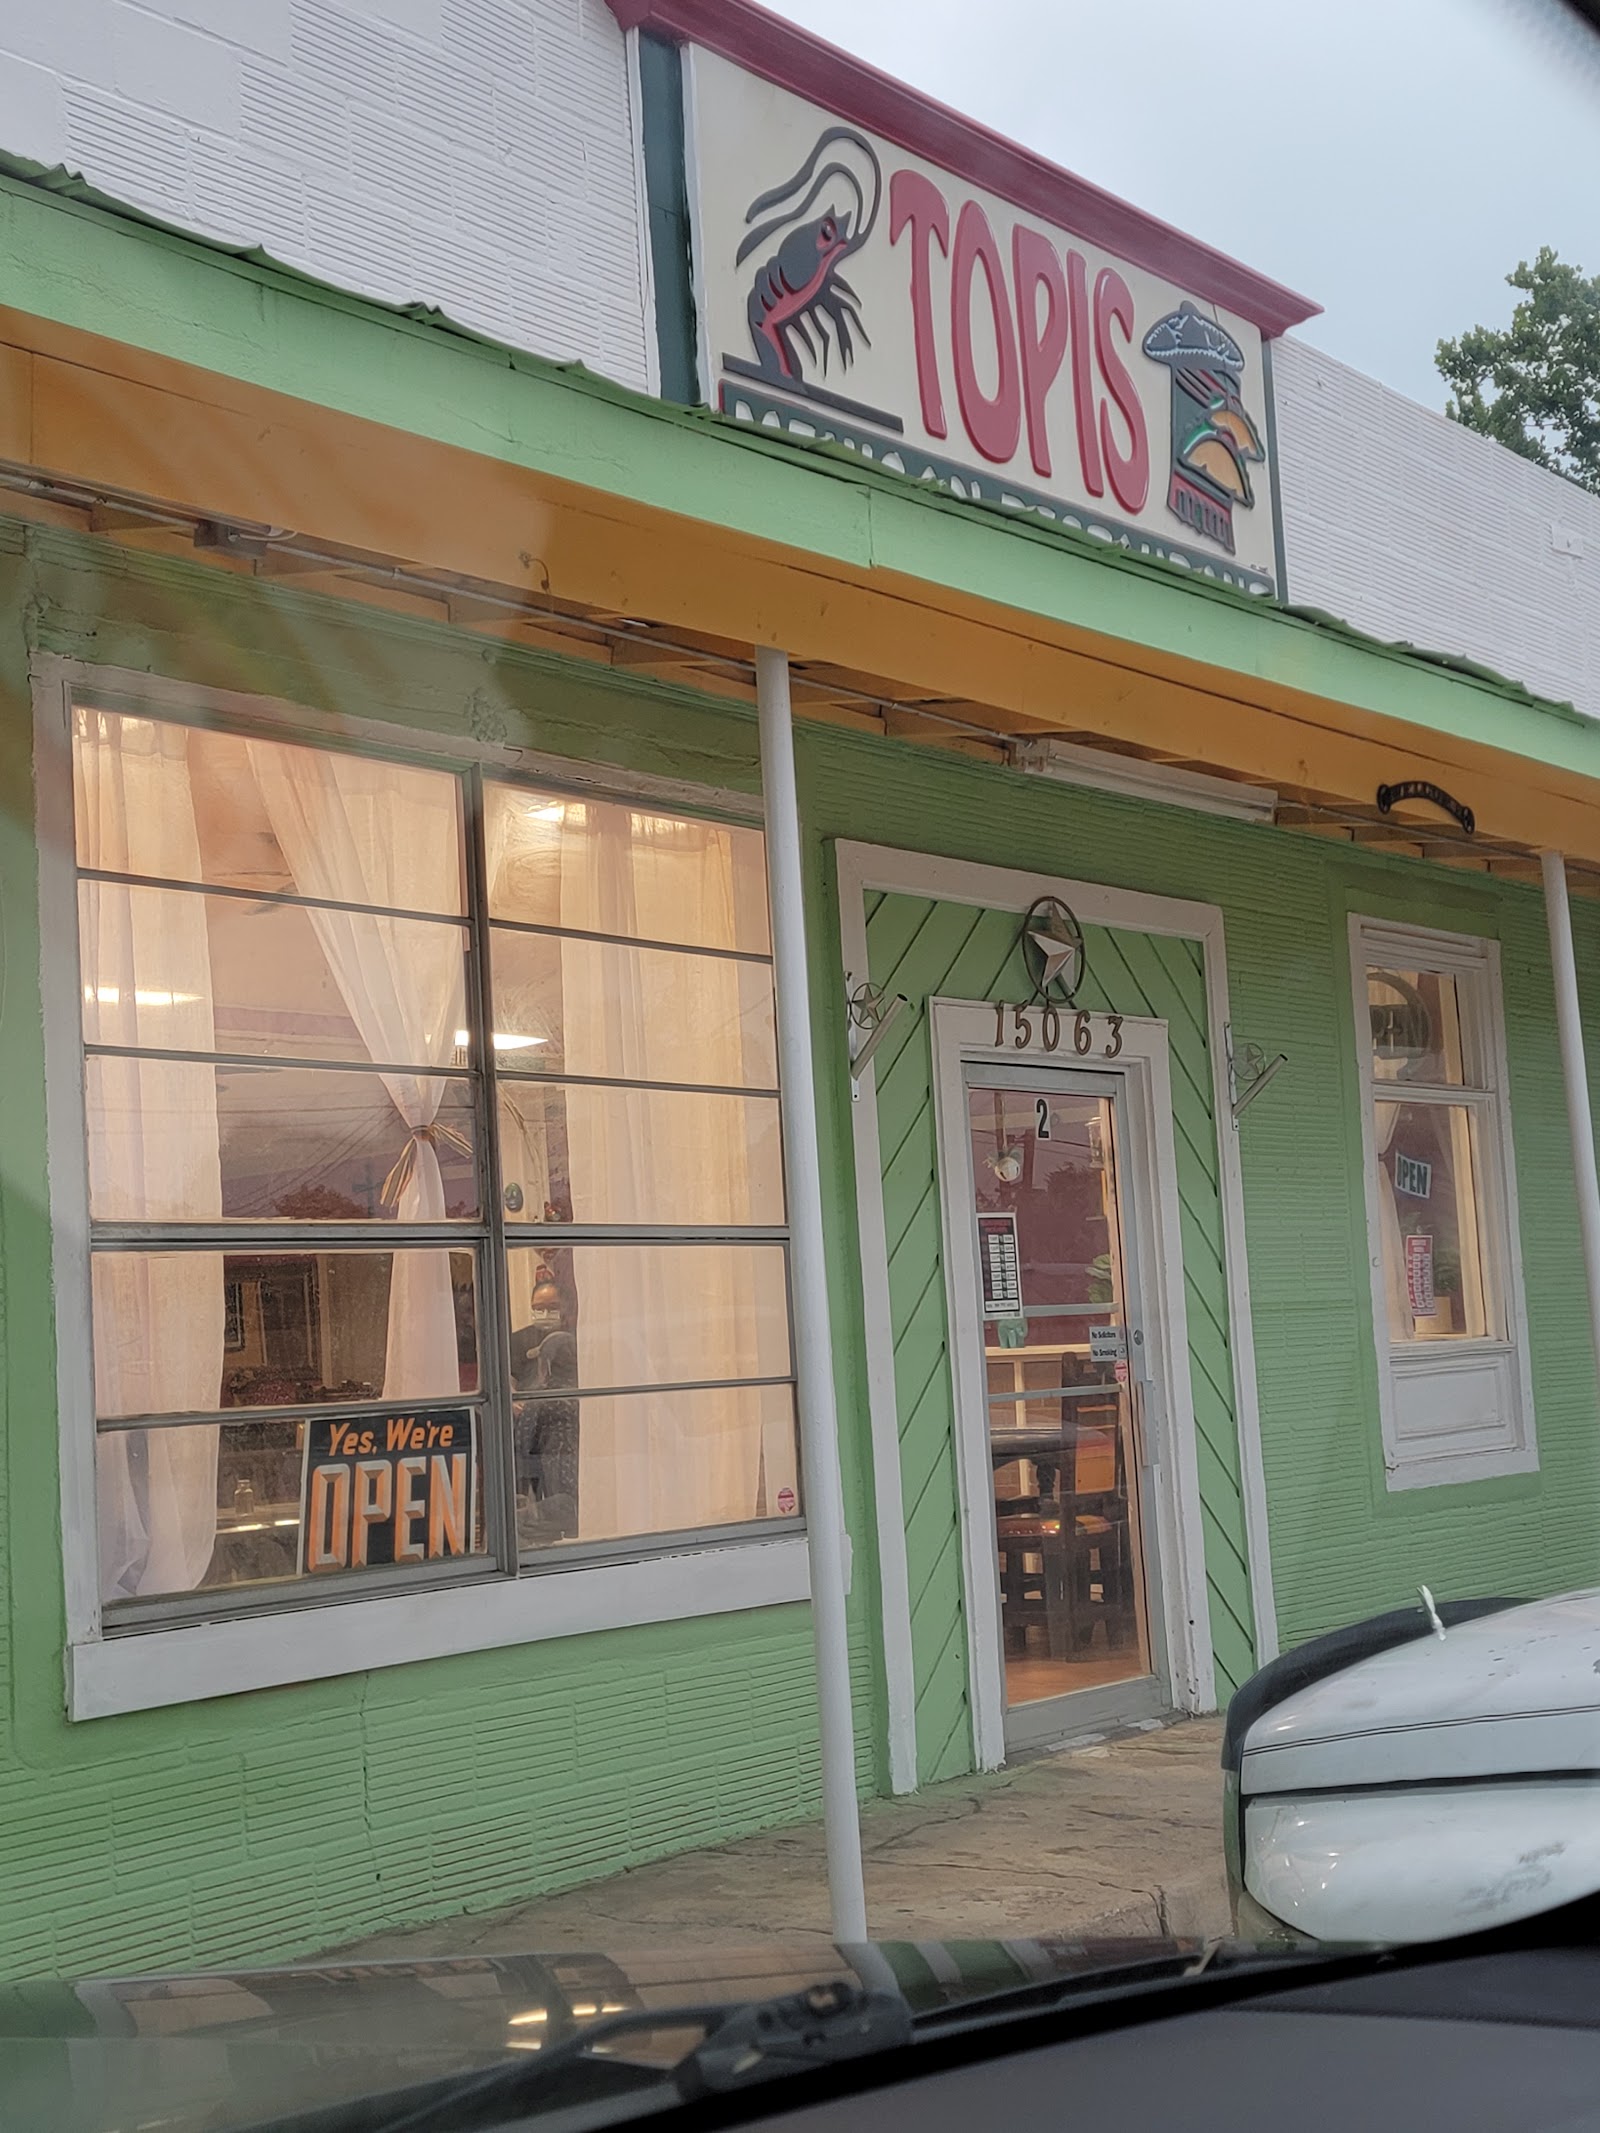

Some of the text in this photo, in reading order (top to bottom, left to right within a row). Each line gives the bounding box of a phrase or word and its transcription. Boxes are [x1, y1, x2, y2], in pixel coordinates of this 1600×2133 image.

[890, 169, 1150, 515] TOPIS
[994, 999, 1124, 1059] 15063
[1036, 1098, 1050, 1138] 2
[328, 1417, 454, 1457] Yes, We're
[307, 1453, 467, 1573] OPEN
